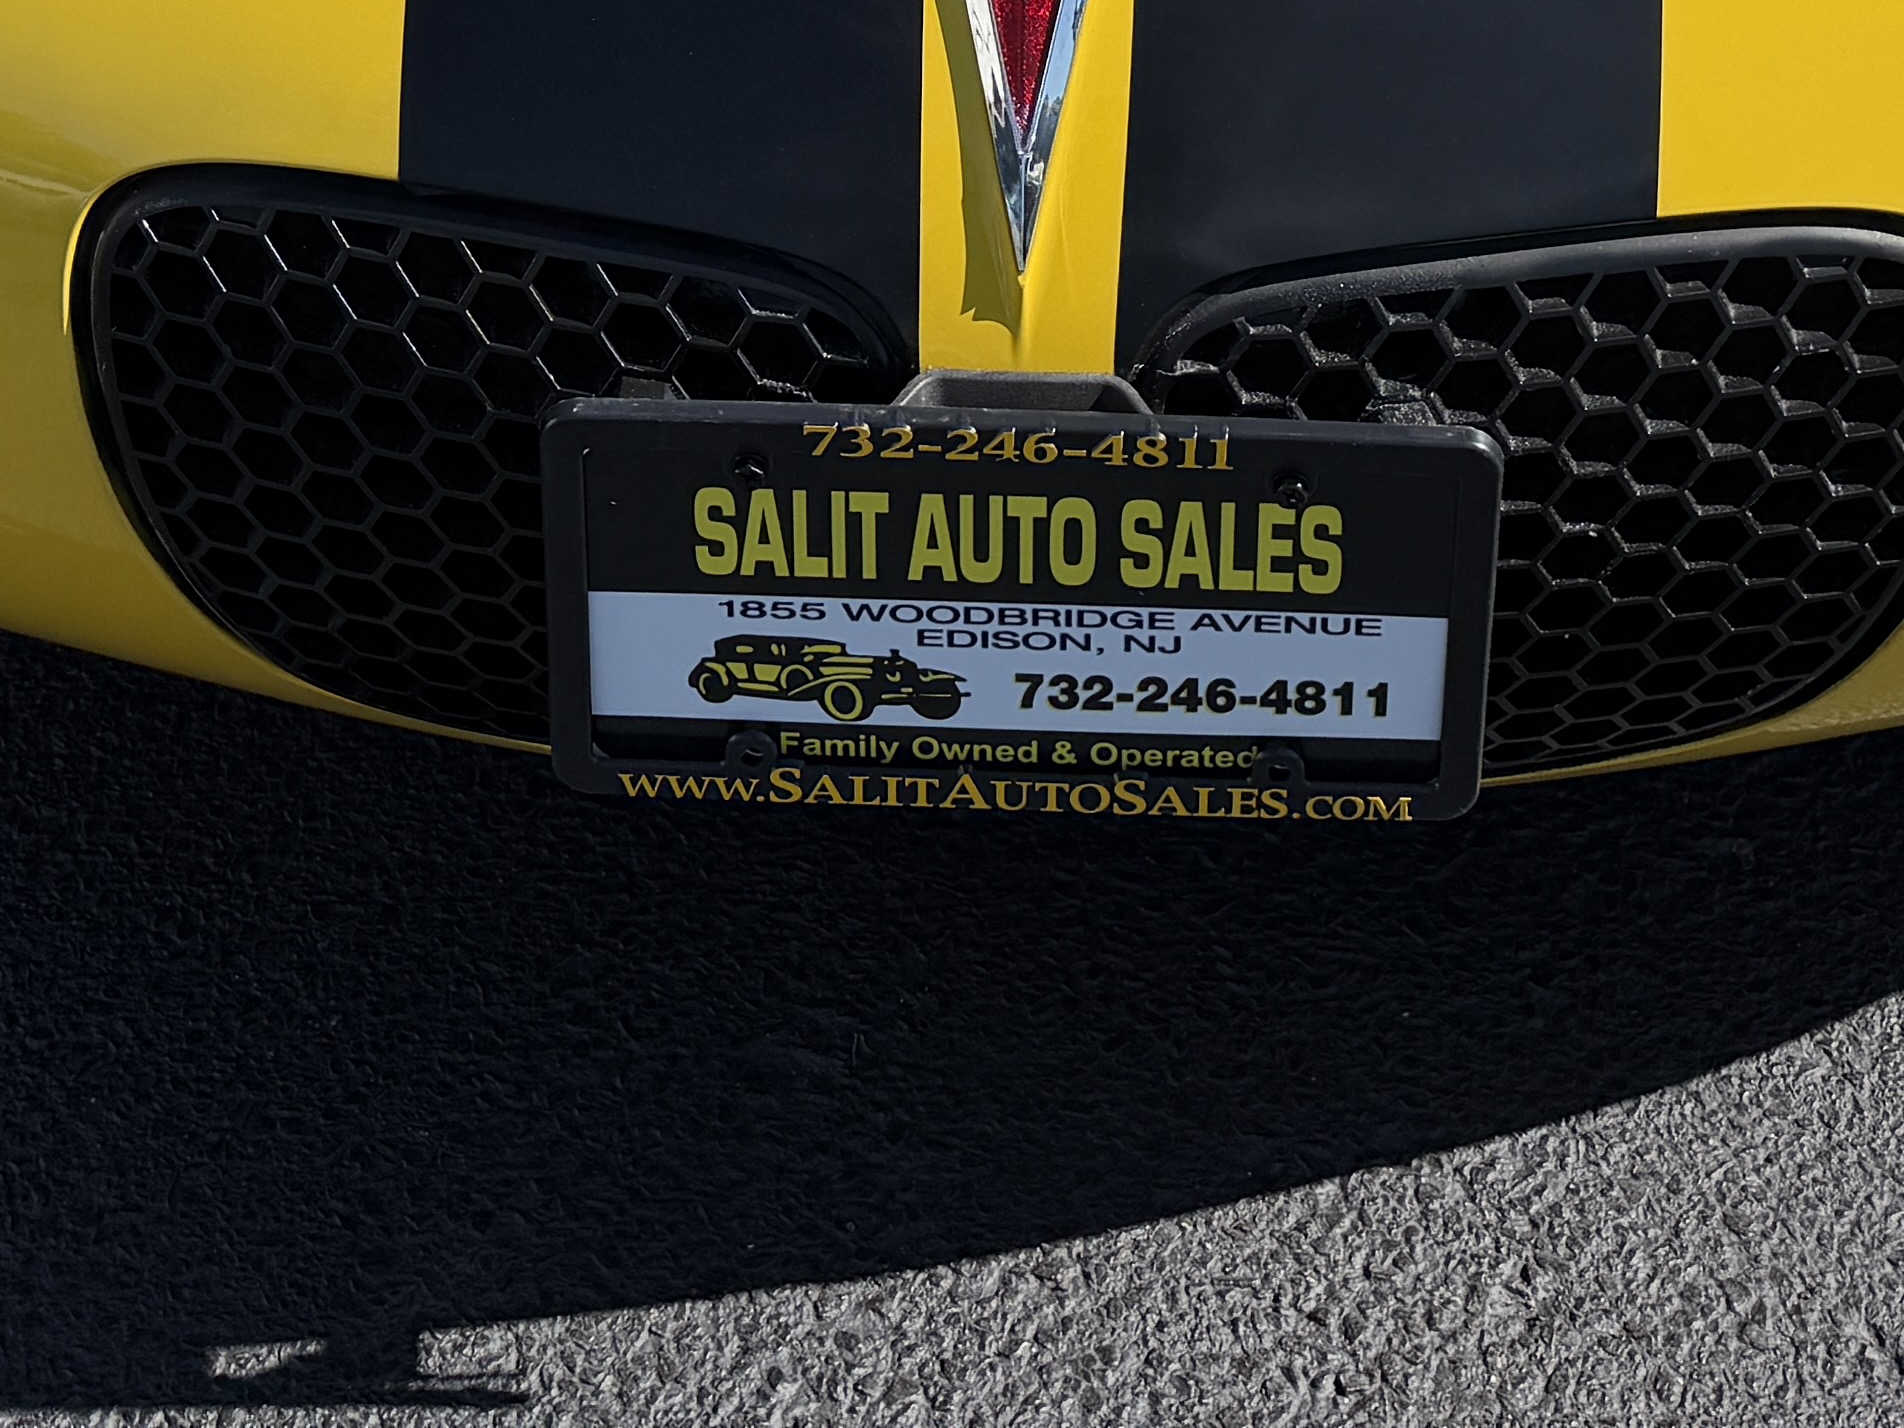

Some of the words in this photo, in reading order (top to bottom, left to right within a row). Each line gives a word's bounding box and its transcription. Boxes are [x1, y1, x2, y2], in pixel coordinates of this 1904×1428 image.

[802, 421, 1235, 470] 732-246-4811
[694, 486, 890, 579] SALIT
[907, 493, 1096, 586] AUTO
[1119, 499, 1343, 594] SALES
[718, 600, 827, 620] 1855
[841, 603, 1176, 631] WOODBRIDGE
[1189, 613, 1383, 637] AVENUE
[916, 629, 1104, 655] EDISON,
[1123, 634, 1182, 655] NJ
[1013, 673, 1390, 718] 732-246-4811
[780, 731, 900, 764] Family
[912, 736, 1038, 764] Owned
[1051, 741, 1077, 765] &
[1090, 742, 1259, 774] Operated
